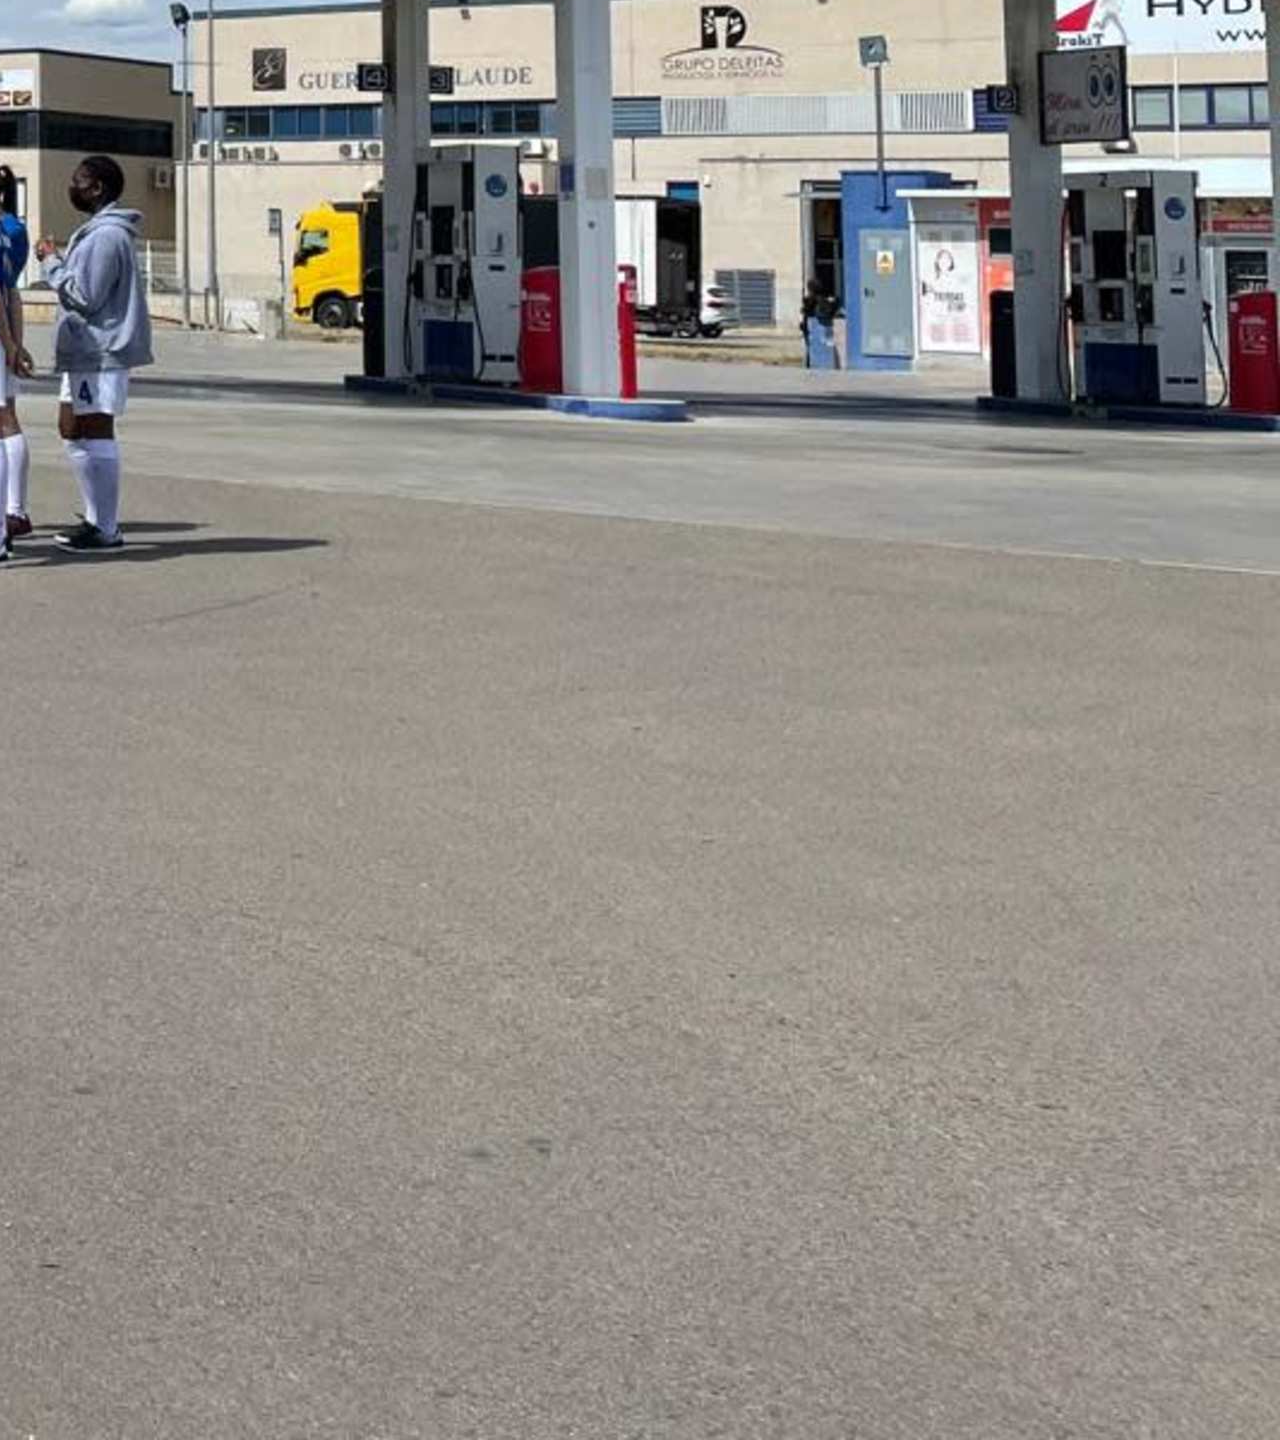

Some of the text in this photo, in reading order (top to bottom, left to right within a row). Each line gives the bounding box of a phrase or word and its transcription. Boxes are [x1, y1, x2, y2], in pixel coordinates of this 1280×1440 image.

[662, 58, 715, 72] GRUPO
[298, 66, 533, 90] GUER LAUDE
